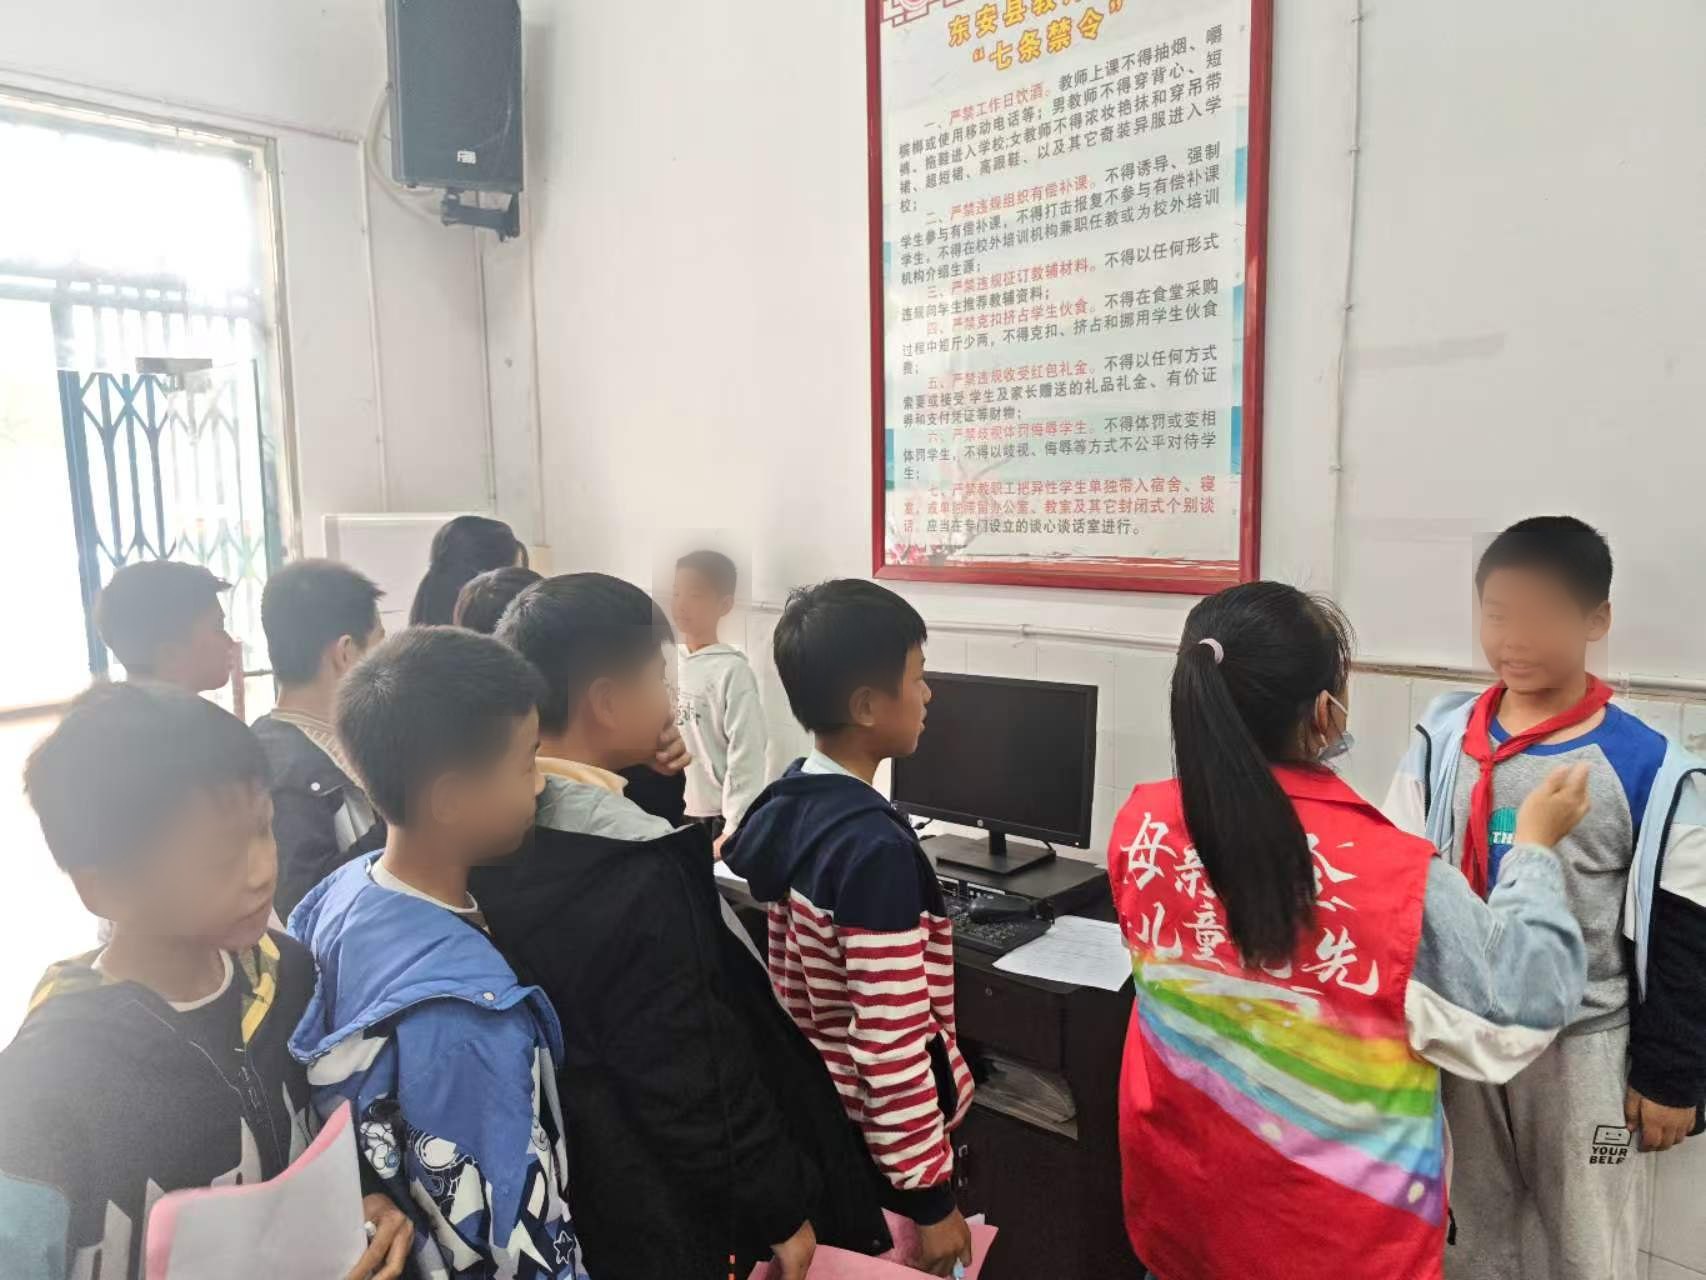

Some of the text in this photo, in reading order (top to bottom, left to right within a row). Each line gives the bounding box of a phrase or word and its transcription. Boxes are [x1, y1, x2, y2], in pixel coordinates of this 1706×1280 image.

[947, 0, 1084, 47] 东安县教
[1119, 811, 1357, 912] 母亲
[1135, 901, 1379, 997] 儿童先
[1591, 1146, 1628, 1157] YOUR
